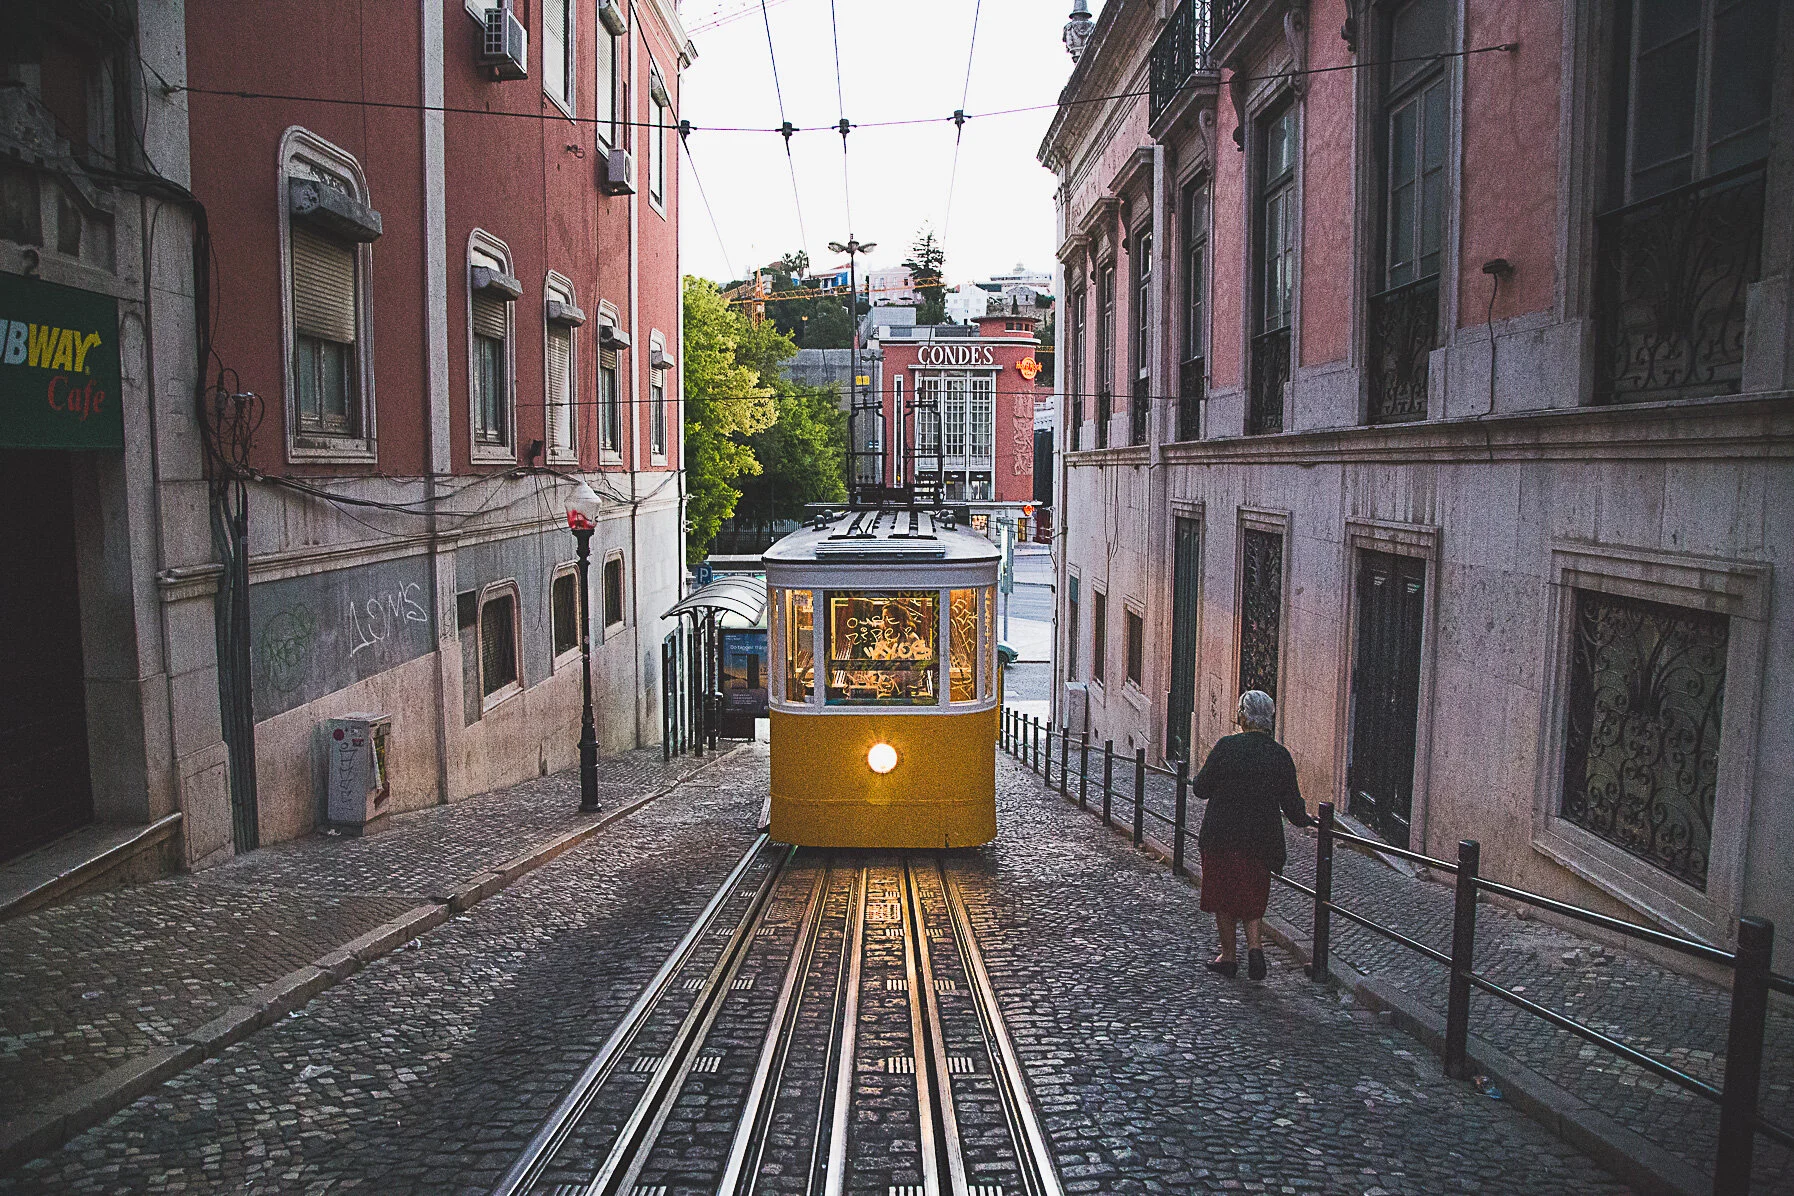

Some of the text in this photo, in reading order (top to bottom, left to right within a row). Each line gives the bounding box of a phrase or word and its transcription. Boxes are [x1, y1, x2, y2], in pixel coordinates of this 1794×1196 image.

[0, 319, 102, 373] BWAY
[917, 345, 994, 365] CONDES
[700, 567, 709, 583] P
